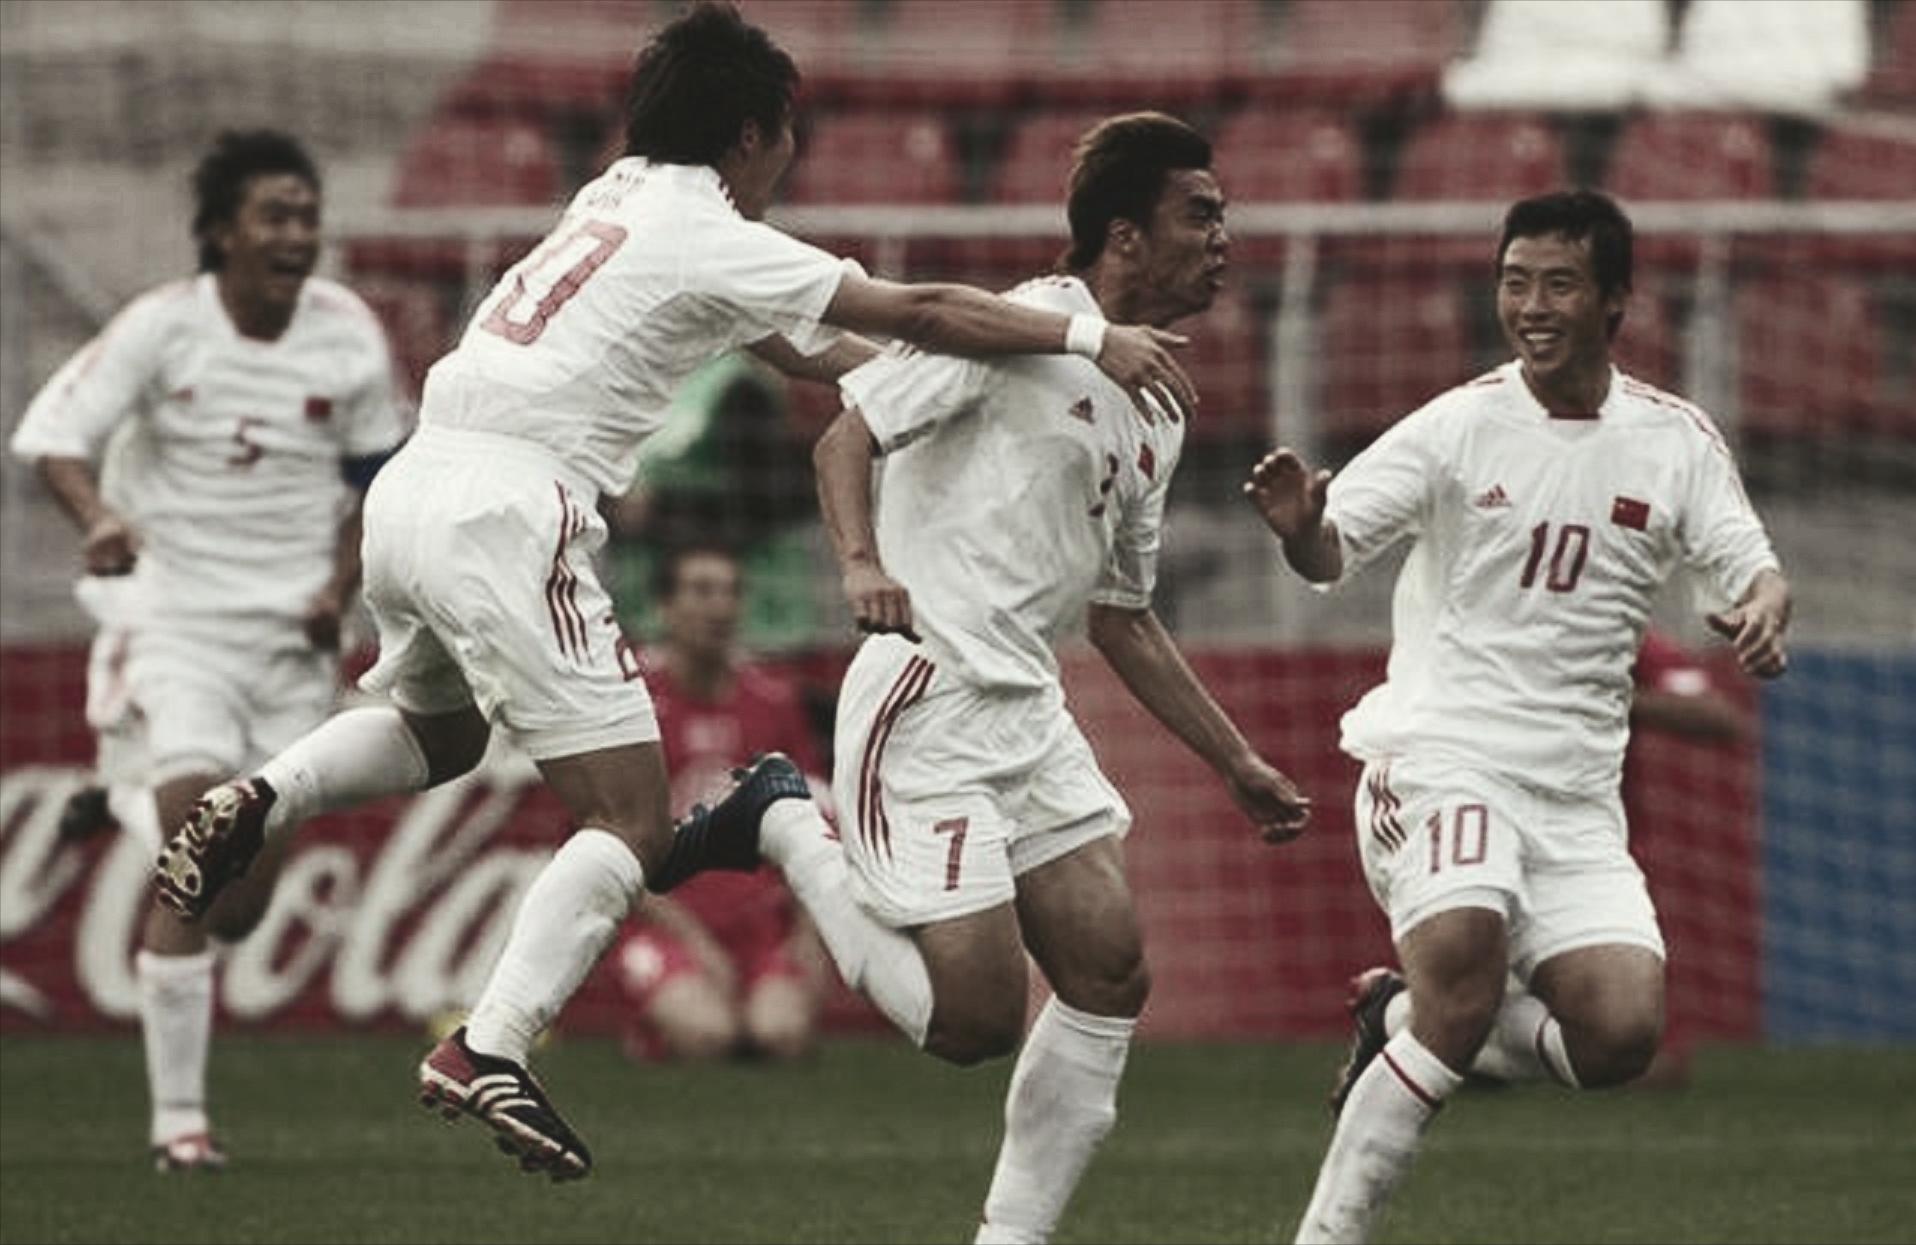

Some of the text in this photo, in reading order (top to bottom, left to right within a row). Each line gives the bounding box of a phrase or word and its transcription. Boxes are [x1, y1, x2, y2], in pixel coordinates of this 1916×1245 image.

[226, 415, 271, 473] 5
[1520, 520, 1591, 592] 10
[933, 816, 969, 891] 7
[1426, 803, 1488, 875] 10
